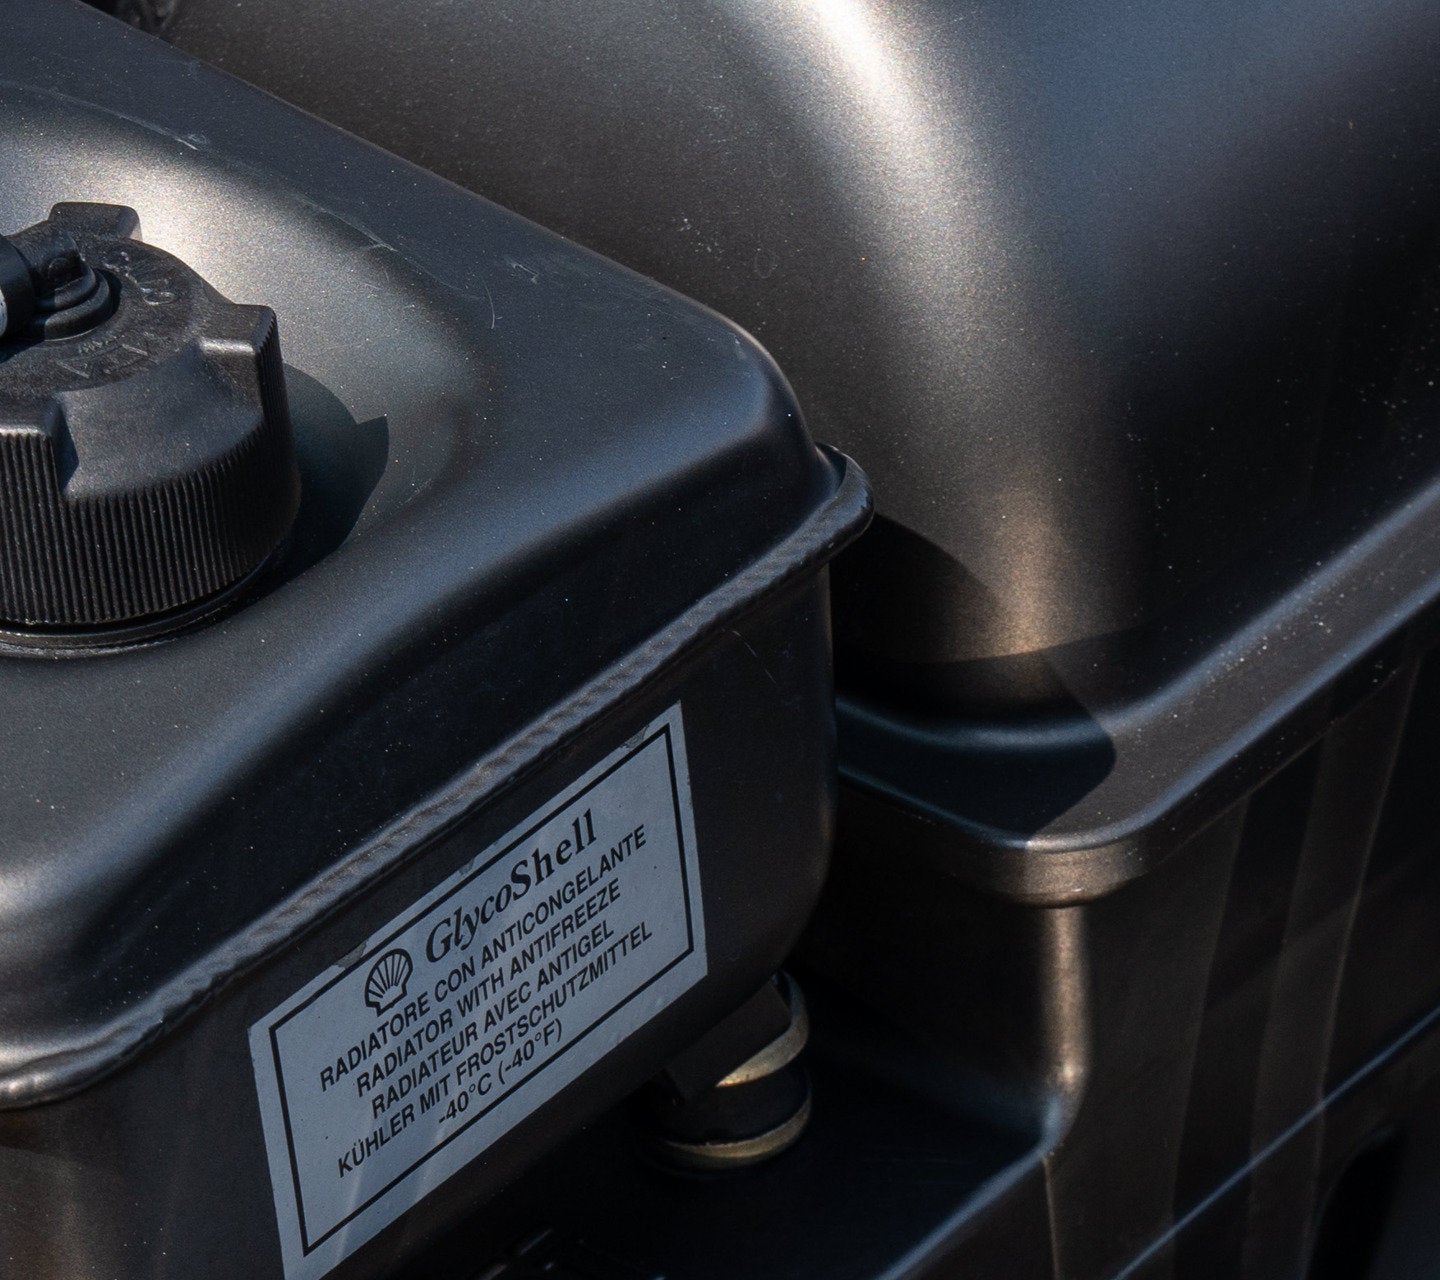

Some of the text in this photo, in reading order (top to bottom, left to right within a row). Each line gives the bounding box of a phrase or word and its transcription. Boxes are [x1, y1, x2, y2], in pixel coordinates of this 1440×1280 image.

[319, 823, 646, 1092] RADIATORE CON ANTICONGELANTE
[356, 877, 620, 1097] RADIATOR WITH ANTIFREEZE
[425, 808, 596, 962] GlycoShell
[338, 921, 652, 1178] KÜHLER MIT FROSTSCHUTZMITTEL
[371, 920, 614, 1119] RADIATEUR AVEC ANTIGEL
[438, 1018, 561, 1123] -40°C (-40°F)
